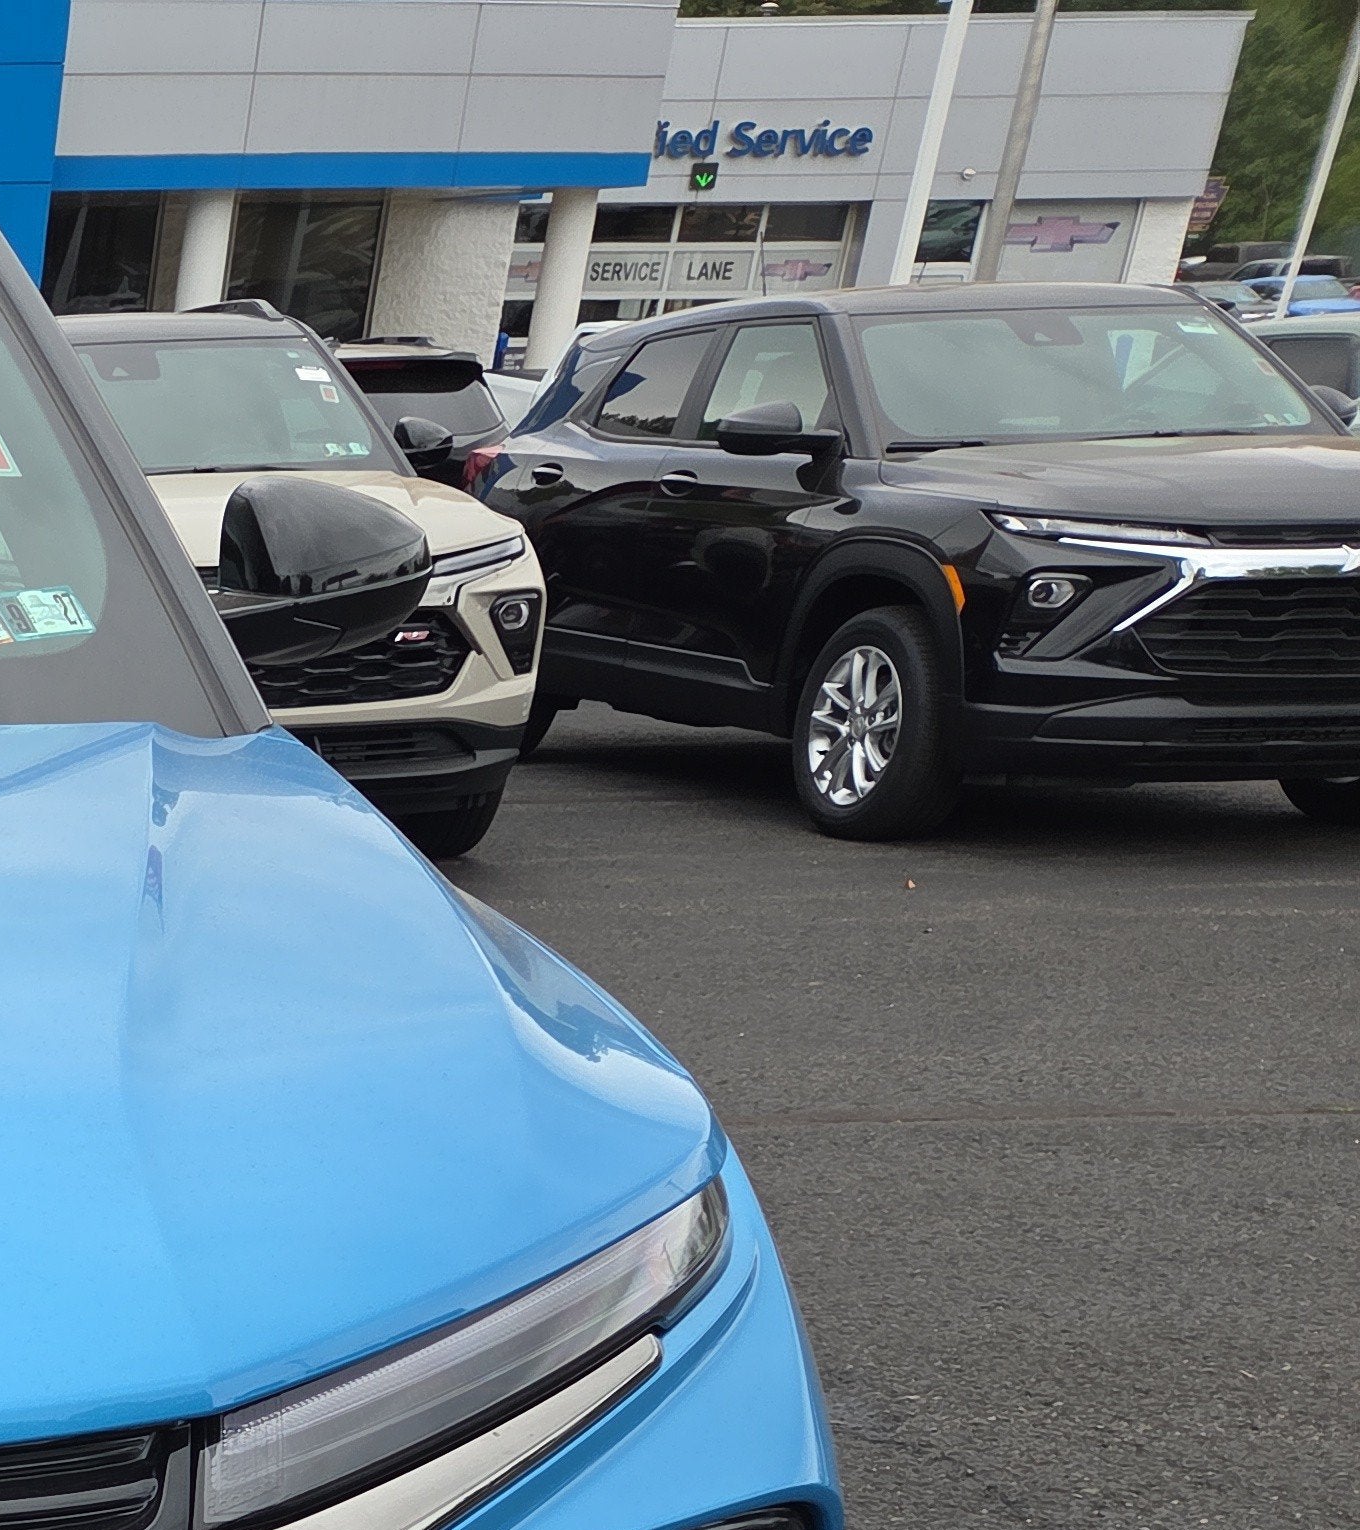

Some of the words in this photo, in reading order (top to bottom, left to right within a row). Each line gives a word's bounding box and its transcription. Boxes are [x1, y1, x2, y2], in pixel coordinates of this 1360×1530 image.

[654, 120, 720, 159] ied
[726, 119, 874, 159] Service
[589, 261, 661, 282] SERVICE
[686, 261, 734, 281] LANE
[5, 603, 32, 633] 9
[53, 592, 84, 627] 27
